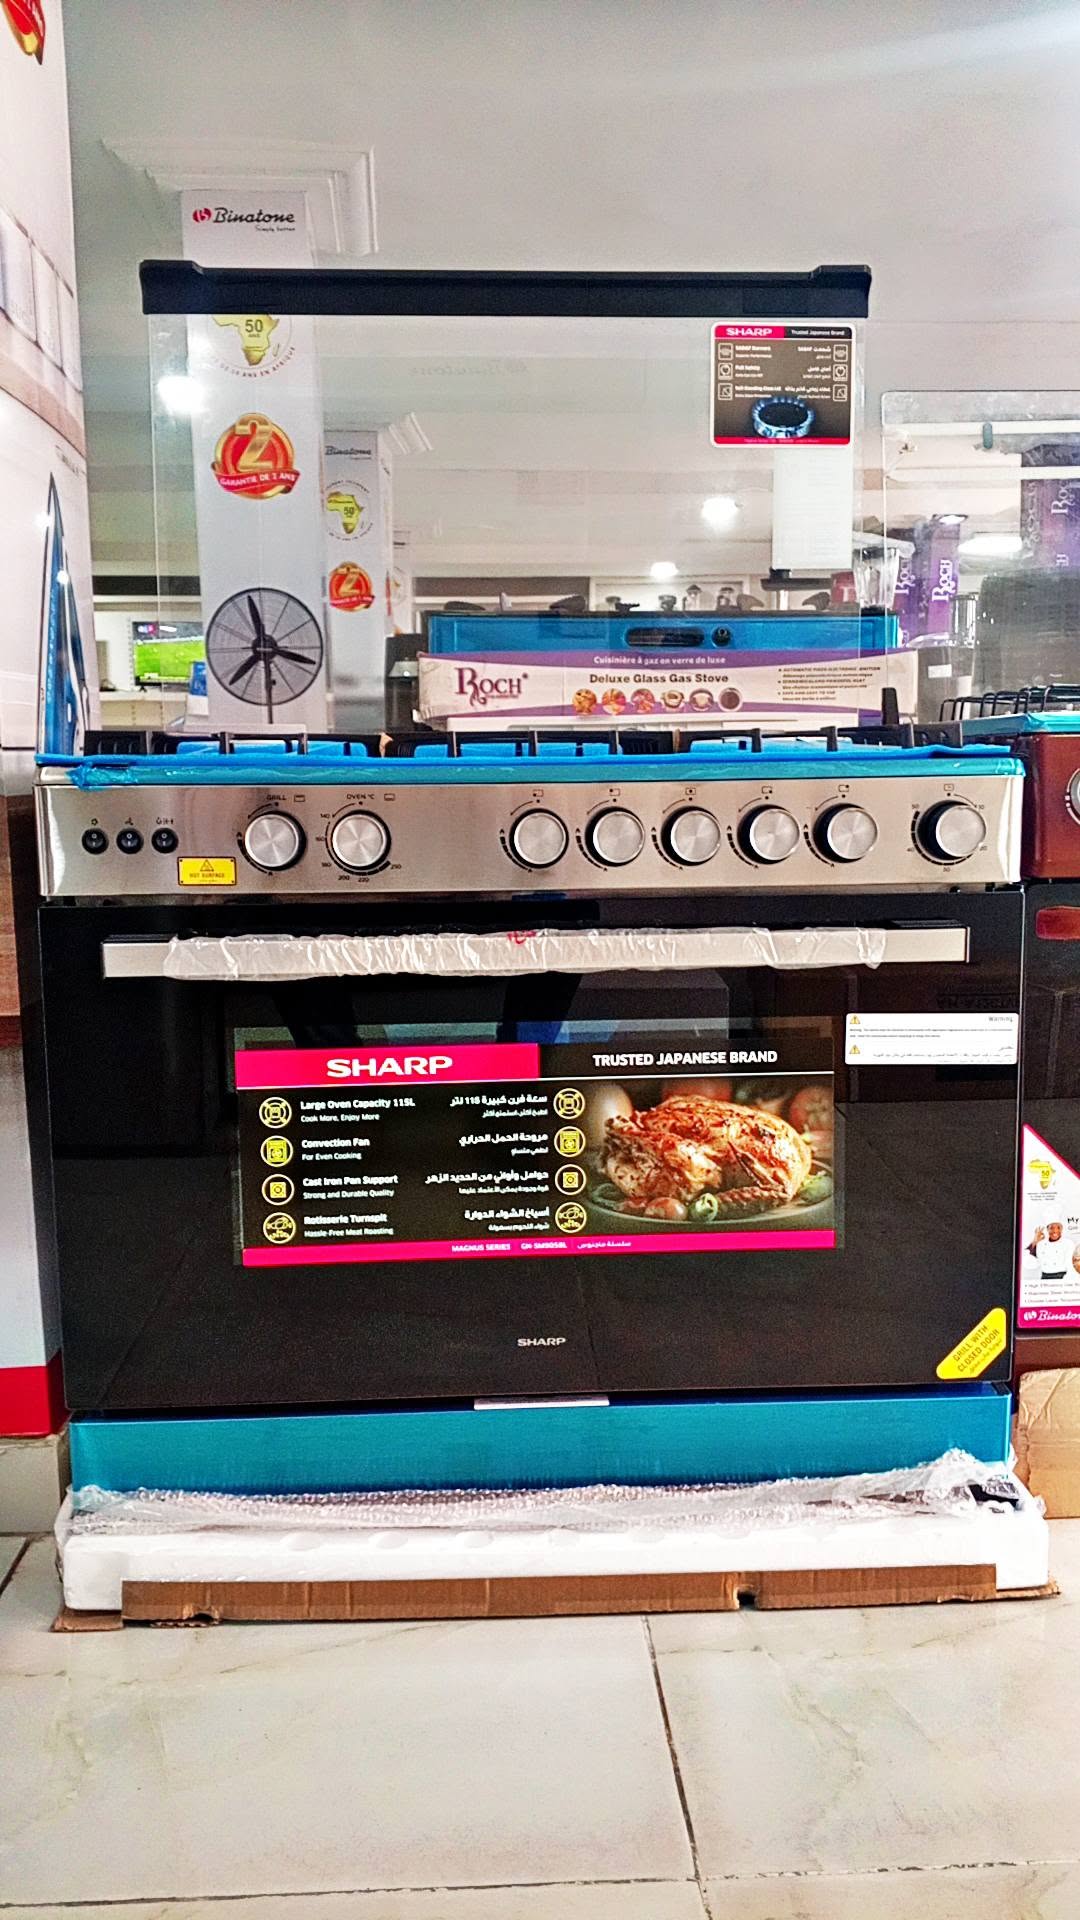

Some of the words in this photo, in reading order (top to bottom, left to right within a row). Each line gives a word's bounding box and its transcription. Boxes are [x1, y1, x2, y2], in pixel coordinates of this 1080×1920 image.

[213, 207, 296, 223] Binatone
[244, 319, 264, 334] 50
[726, 327, 773, 336] SHARP
[235, 420, 274, 472] 2
[325, 446, 372, 455] Binatone
[219, 477, 258, 487] GARANTIE
[259, 473, 270, 482] DE
[279, 472, 297, 482] ANS
[593, 656, 636, 664] Cuisinière
[637, 654, 643, 664] à
[695, 656, 706, 664] de
[707, 655, 726, 664] luxe
[589, 674, 631, 684] Deluxe
[633, 673, 667, 683] Glass
[669, 673, 692, 683] Gas
[694, 673, 729, 683] Stove
[592, 1053, 654, 1067] TRUSTED
[656, 1051, 727, 1065] JAPANESE
[729, 1050, 778, 1063] BRAND
[326, 1056, 454, 1078] SHARP
[300, 1101, 326, 1111] Large
[327, 1100, 352, 1109] Oven
[353, 1099, 391, 1110] Capacity
[300, 1115, 319, 1123] Cook
[340, 1113, 361, 1123] Enjoy
[361, 1112, 380, 1121] More
[518, 1132, 549, 1143] مروحة
[301, 1139, 352, 1149] Convection
[353, 1138, 371, 1147] Fan
[301, 1153, 314, 1161] For
[315, 1153, 333, 1161] Even
[333, 1152, 362, 1161] Cooking
[302, 1178, 323, 1187] Cast
[323, 1177, 343, 1186] Iron
[343, 1176, 362, 1185] Pan
[362, 1174, 399, 1185] Support
[303, 1191, 327, 1200] Strong
[326, 1190, 341, 1198] and
[341, 1190, 369, 1198] Durable
[369, 1189, 395, 1198] Quality
[303, 1215, 350, 1225] Rotisserie
[349, 1213, 388, 1224] Turnspit
[304, 1230, 345, 1238] Hassle-Free
[345, 1229, 363, 1237] Meat
[363, 1227, 394, 1237] Roasting
[451, 1244, 484, 1252] MAGNUS
[485, 1243, 511, 1251] SERIES
[970, 1324, 989, 1344] WITH
[517, 1337, 567, 1346] SHARP
[957, 1346, 983, 1373] CLOSED
